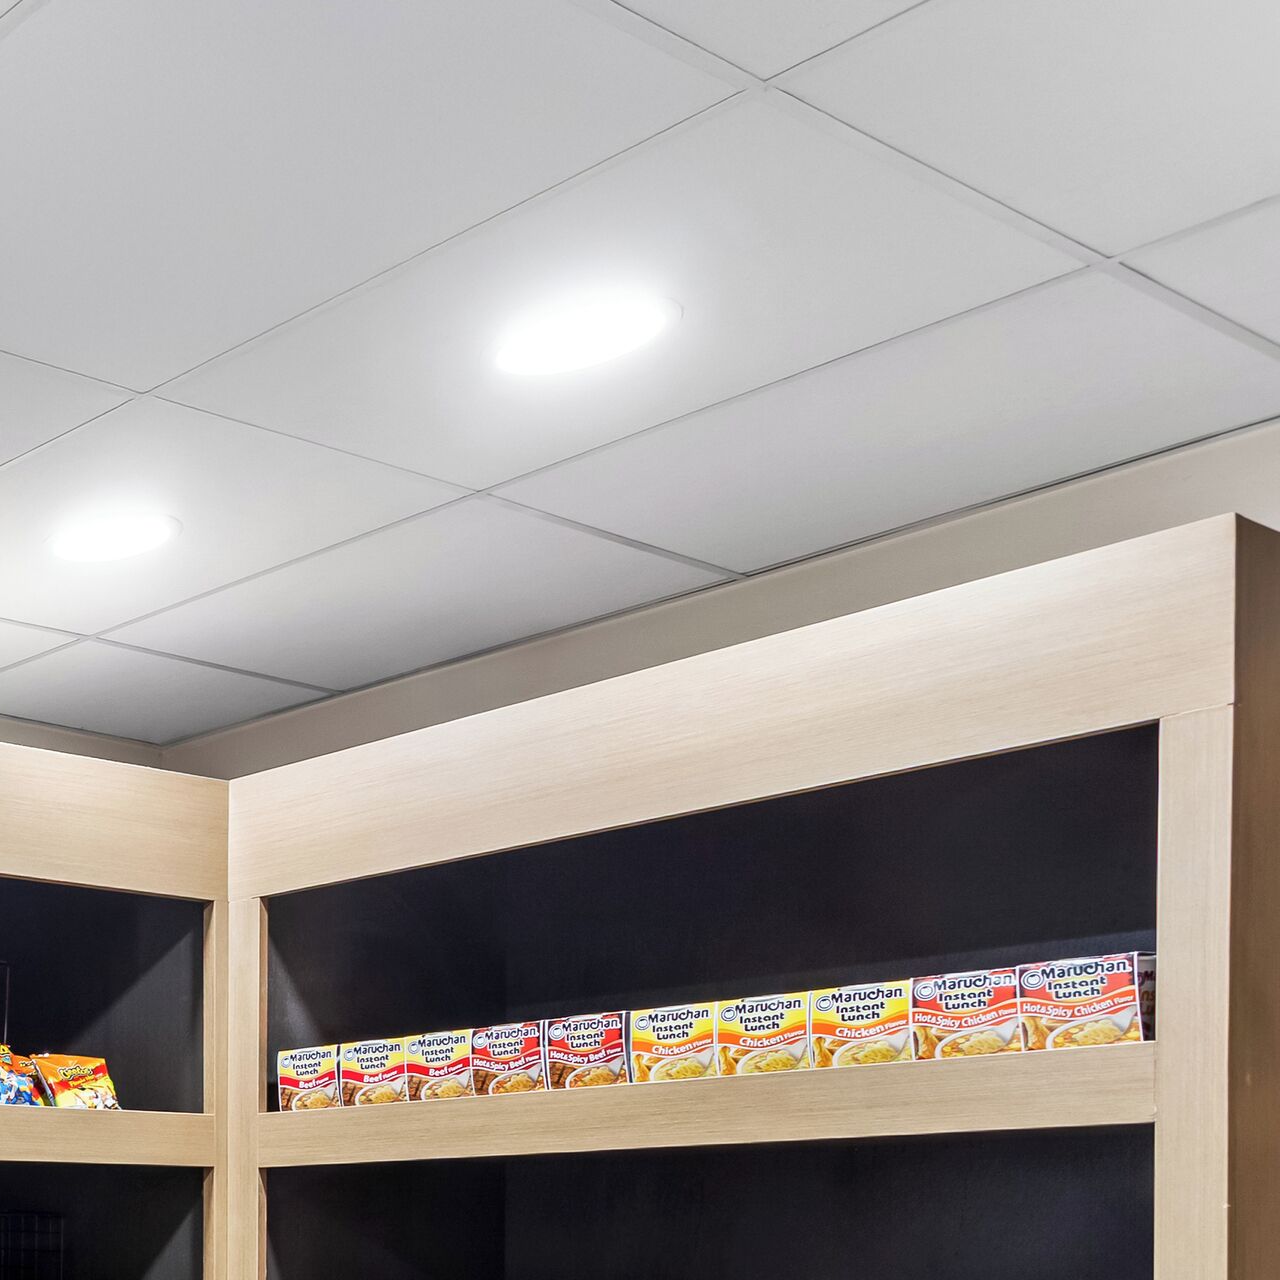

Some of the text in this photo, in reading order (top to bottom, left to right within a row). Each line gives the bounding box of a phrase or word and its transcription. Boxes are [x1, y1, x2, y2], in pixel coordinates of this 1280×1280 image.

[1040, 961, 1126, 979] Maruchan
[934, 974, 1012, 991] Maruchan
[1047, 976, 1106, 990] Instant
[831, 988, 902, 1003] Maruchan
[938, 990, 993, 1001] Instant
[1054, 987, 1100, 1000] Lunch
[735, 999, 801, 1014] Maruchan
[836, 1002, 885, 1014] Instant
[945, 1000, 987, 1010] Lunch
[1074, 999, 1114, 1017] Chicken
[649, 1008, 709, 1024] Maruchan
[740, 1013, 784, 1023] Instant
[841, 1012, 880, 1021] Lunch
[962, 1011, 997, 1028] Chicken
[562, 1018, 620, 1032] Maruchan
[653, 1023, 693, 1033] Instant
[744, 1022, 780, 1031] Lunch
[485, 1026, 537, 1040] Maruchan
[566, 1031, 604, 1040] Instant
[657, 1030, 689, 1040] Lunch
[836, 1025, 885, 1038] Chicken
[418, 1035, 466, 1048] Maruchan
[488, 1039, 523, 1049] Instant
[571, 1039, 600, 1049] Lunch
[740, 1034, 784, 1048] Chicken
[353, 1043, 401, 1056] Maruchan
[422, 1047, 454, 1056] Instant
[493, 1047, 520, 1056] Lunch
[653, 1041, 693, 1055] Chicken
[290, 1051, 332, 1062] Maruchan
[357, 1054, 389, 1062] Instant
[426, 1055, 451, 1063] Lunch
[589, 1049, 606, 1061] Beef
[292, 1061, 321, 1070] Instant
[360, 1062, 386, 1070] Lunch
[296, 1068, 318, 1076] Lunch
[429, 1066, 448, 1077] Beef
[363, 1073, 383, 1084] Beef
[299, 1080, 315, 1089] Beef
